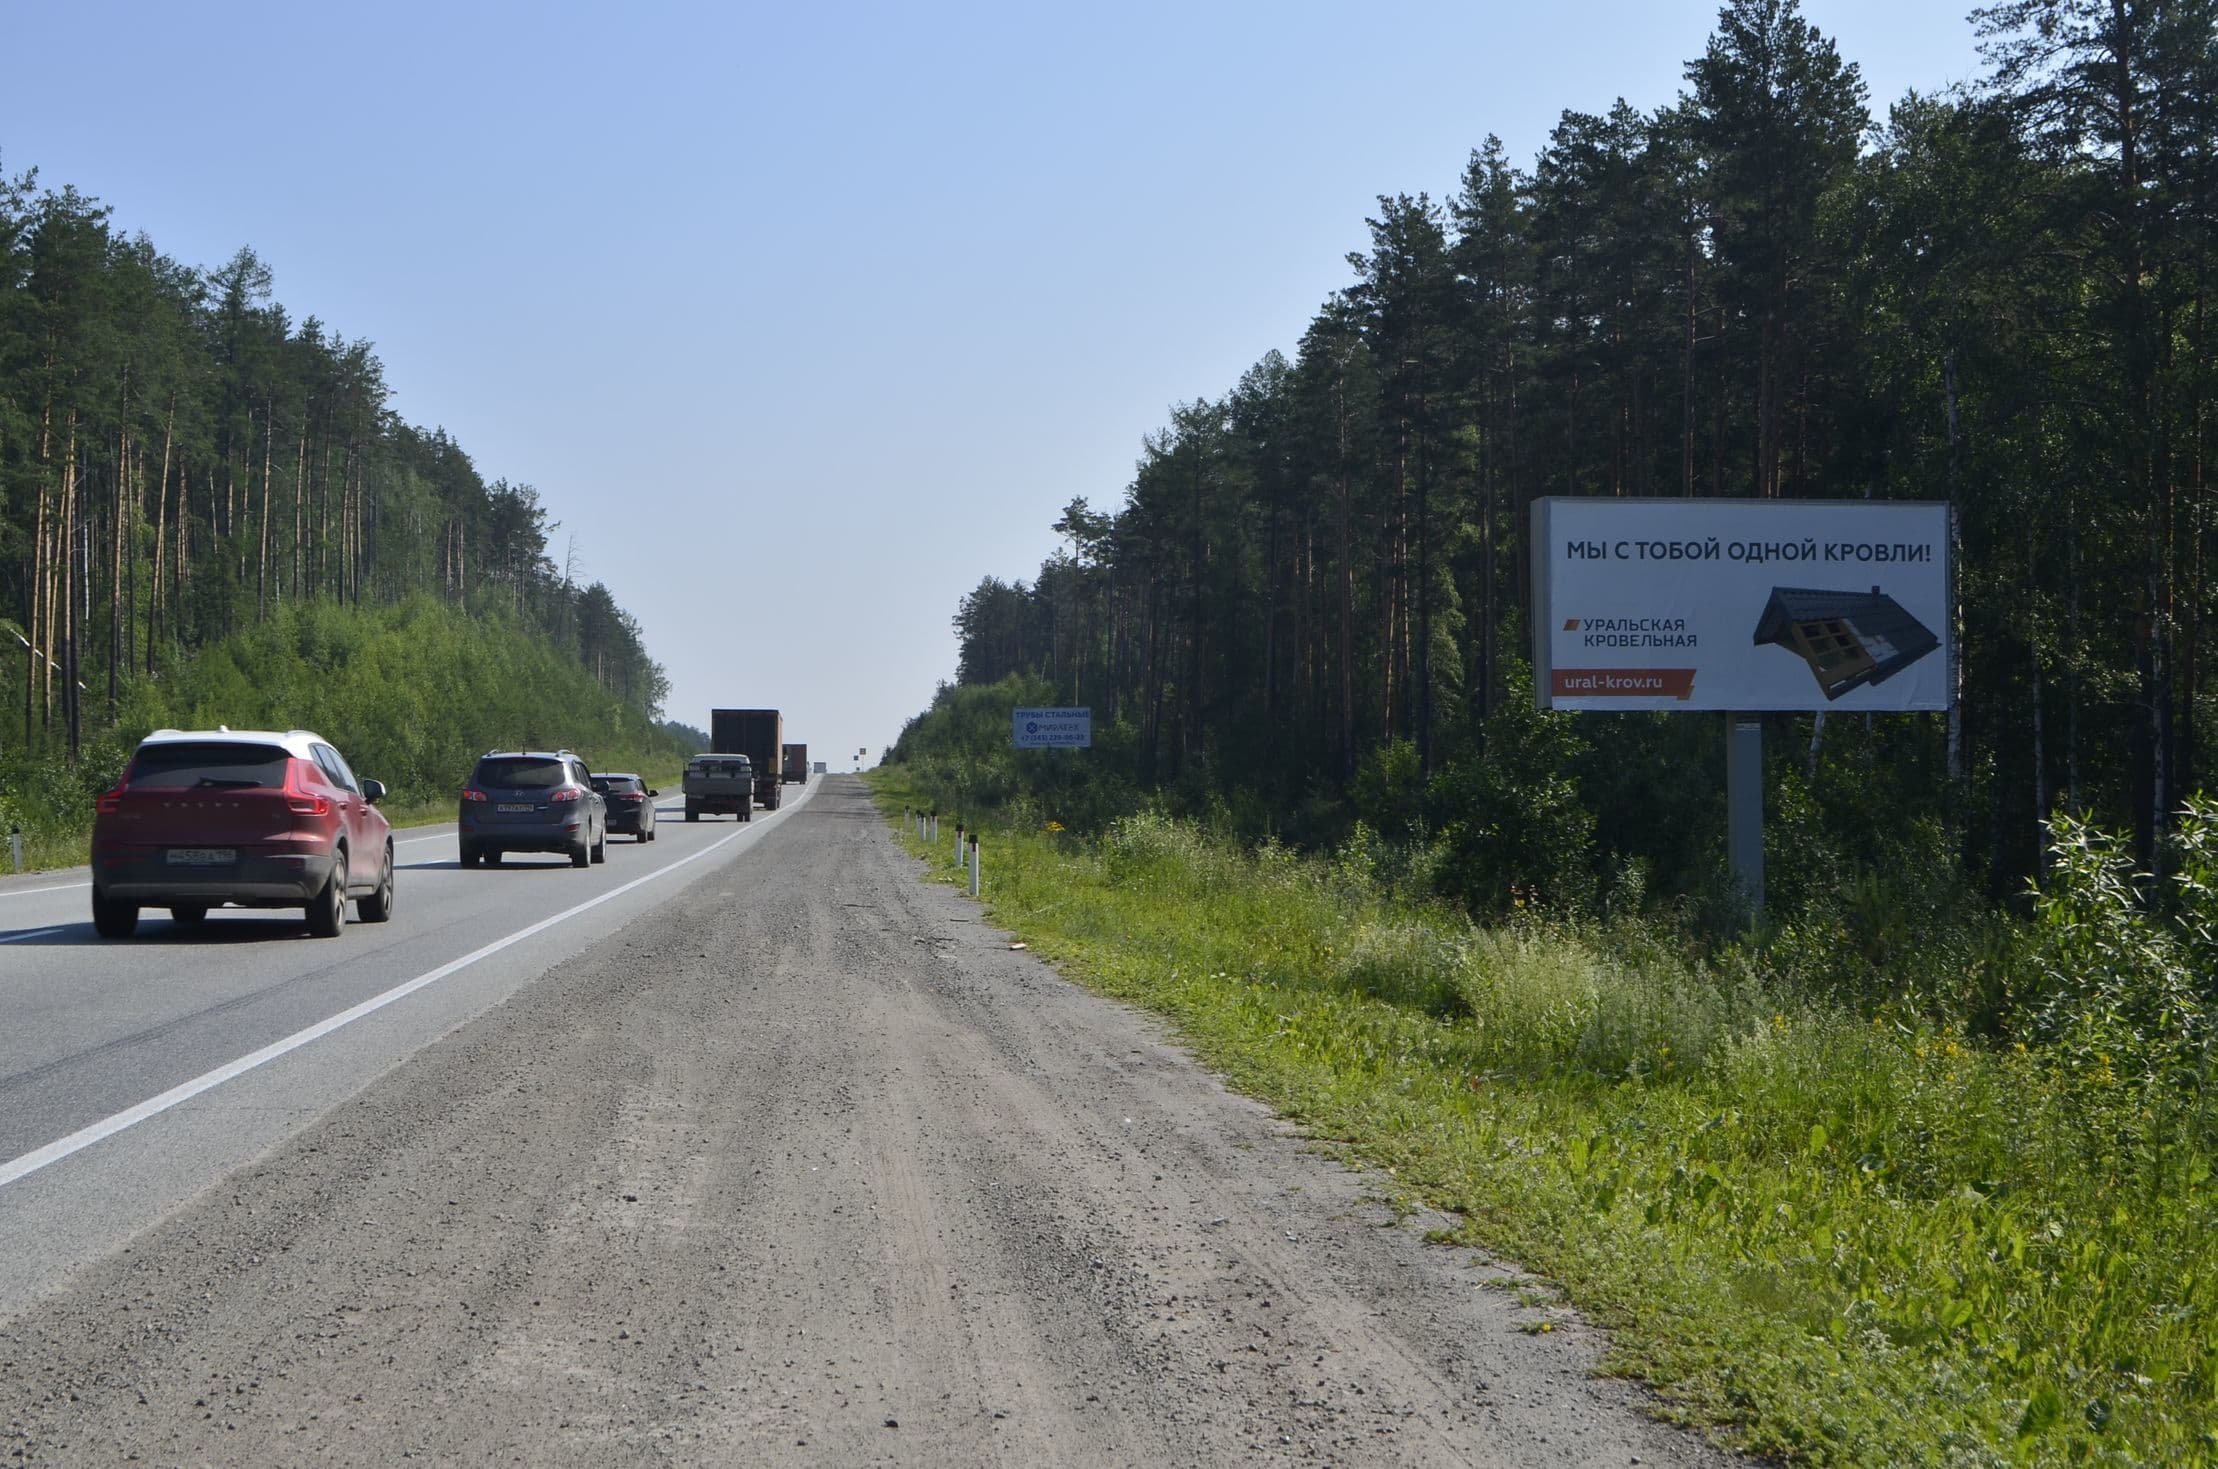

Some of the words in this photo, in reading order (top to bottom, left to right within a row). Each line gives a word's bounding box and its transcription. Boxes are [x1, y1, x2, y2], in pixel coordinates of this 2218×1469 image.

[1566, 540, 1607, 560] МЫ
[1614, 540, 1630, 560] С
[1634, 536, 1721, 560] ТОБОЙ
[1727, 537, 1817, 564] ОДНОЙ
[1824, 542, 1932, 563] КРОВЛИ!
[1583, 618, 1686, 632] УРАЛЬСКАЯ
[1584, 634, 1697, 648] КРОВЕЛЬНАЯ
[1563, 674, 1663, 689] ural-krov.ru
[1015, 711, 1043, 719] ТРУБЫ
